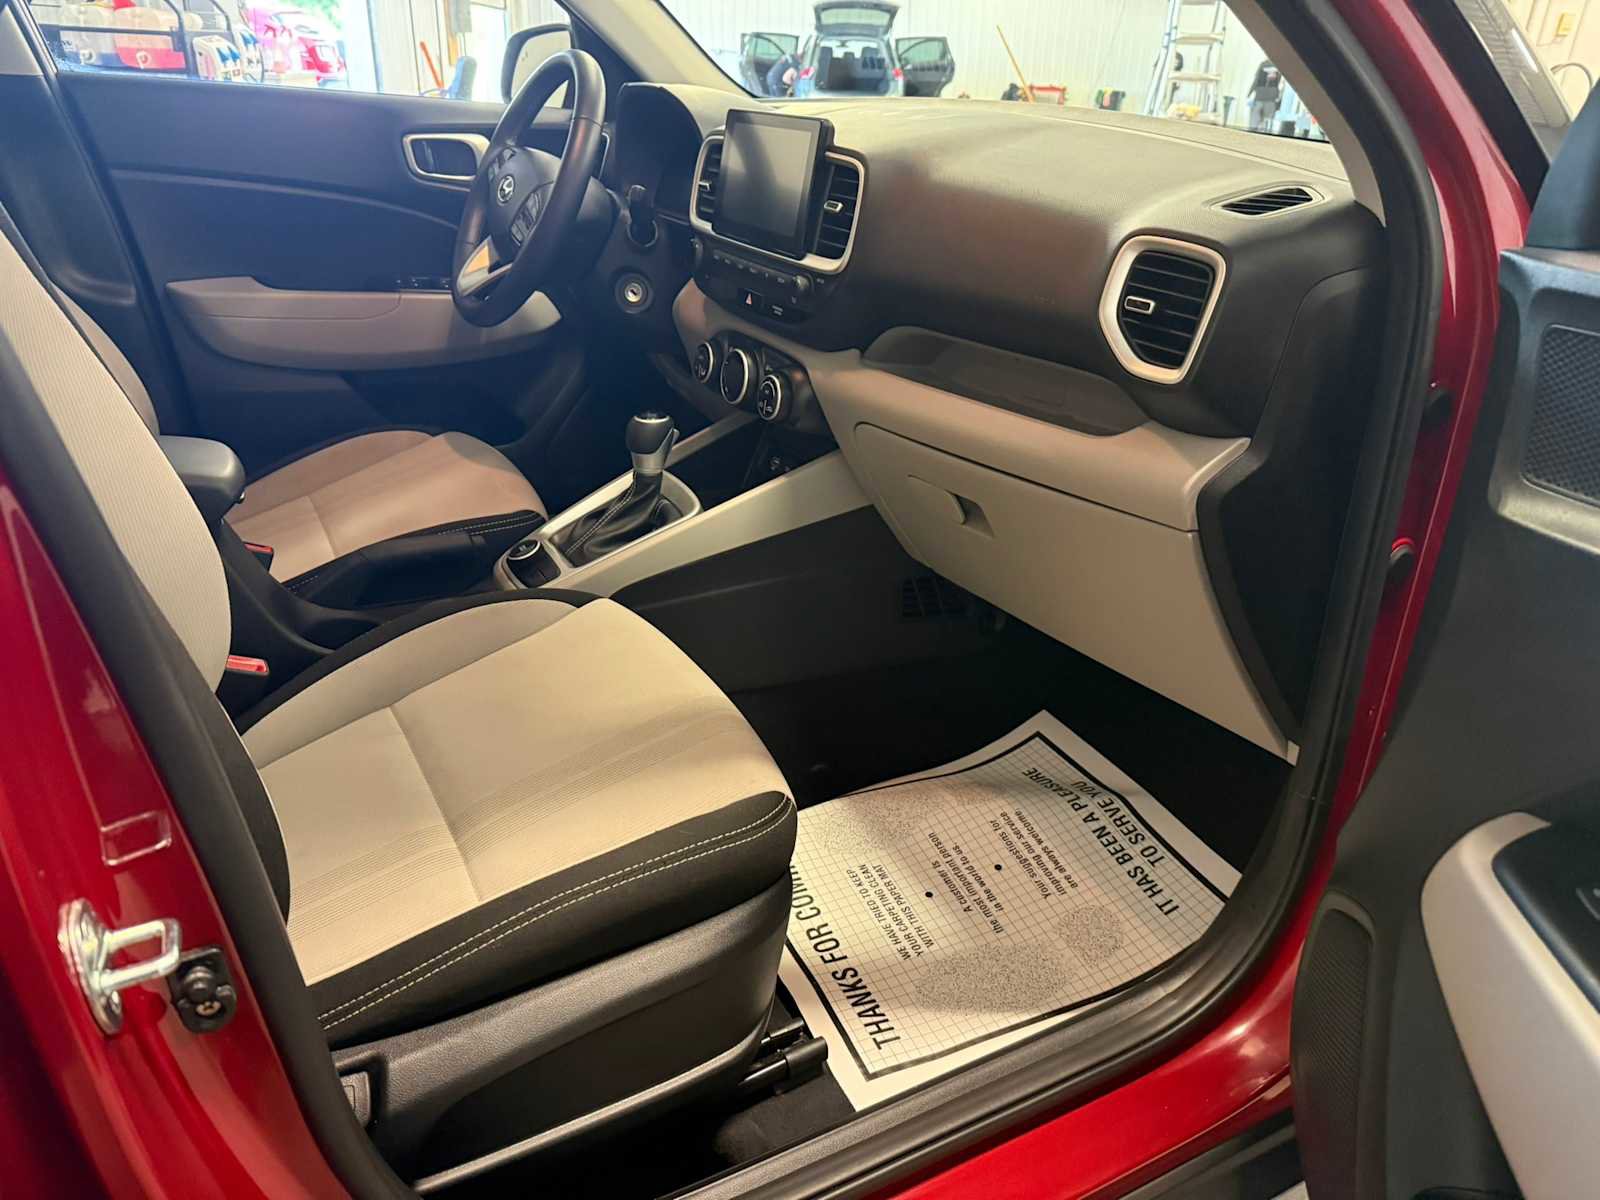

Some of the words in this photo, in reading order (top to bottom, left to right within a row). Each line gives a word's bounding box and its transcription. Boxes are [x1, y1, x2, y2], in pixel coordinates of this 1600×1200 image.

[1021, 766, 1089, 812] PLEASURE
[1070, 778, 1103, 799] YOU
[988, 818, 1003, 832] for
[1081, 810, 1101, 824] A
[1096, 795, 1147, 846] SERVE
[926, 831, 952, 860] person
[997, 830, 1040, 880] suggestions
[1020, 839, 1036, 855] our
[1091, 825, 1134, 866] BEEN
[1139, 843, 1166, 868] TO
[871, 863, 890, 881] MAT
[930, 859, 942, 869] is
[958, 855, 970, 866] to
[1040, 844, 1068, 875] always
[845, 867, 865, 888] KEEP
[857, 863, 880, 889] CLEAN
[937, 868, 968, 906] customer
[944, 857, 980, 897] important
[964, 864, 987, 889] world
[1032, 853, 1068, 896] improving
[1062, 873, 1079, 890] are
[1126, 863, 1164, 899] HAS
[789, 865, 821, 920] COM
[858, 887, 871, 900] TO
[883, 878, 907, 906] PAPER
[981, 887, 998, 903] the
[1033, 878, 1053, 900] Your
[865, 897, 888, 924] TRIED
[873, 887, 909, 933] CARPETING
[900, 904, 919, 926] THIS
[961, 904, 974, 913] A
[972, 896, 994, 919] most
[992, 902, 1005, 913] in
[1154, 895, 1180, 917] IT
[881, 922, 903, 945] HAVE
[913, 923, 935, 949] WITH
[988, 918, 1005, 934] the
[804, 922, 849, 966] FOR
[896, 945, 913, 961] WE
[902, 931, 925, 957] YOUR
[831, 965, 901, 1051] THANKS
